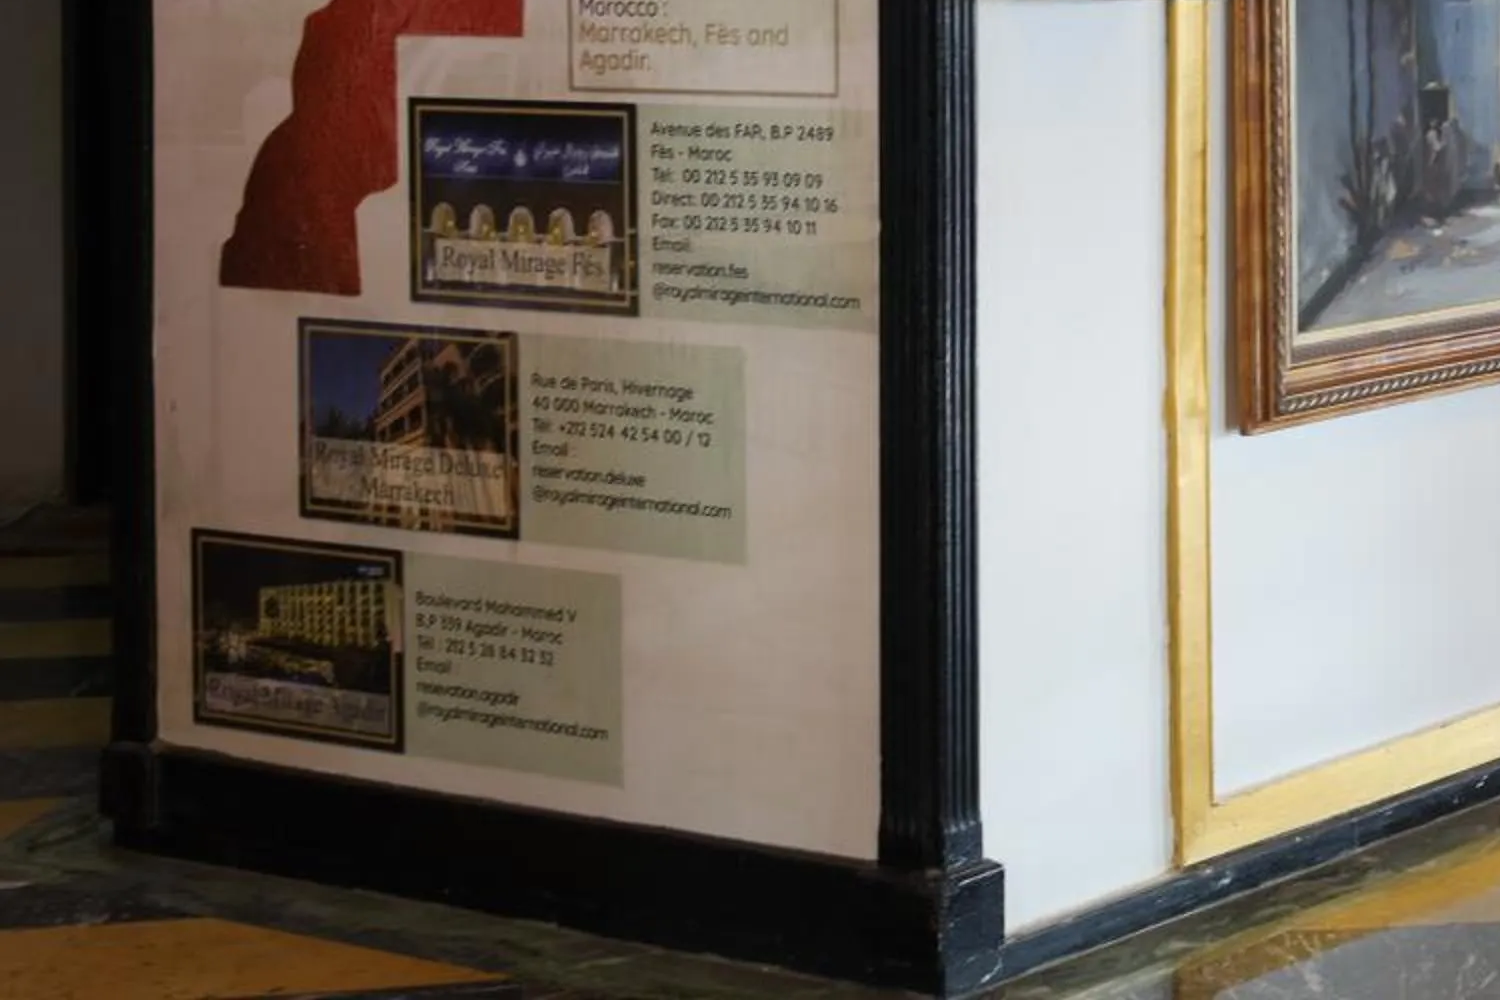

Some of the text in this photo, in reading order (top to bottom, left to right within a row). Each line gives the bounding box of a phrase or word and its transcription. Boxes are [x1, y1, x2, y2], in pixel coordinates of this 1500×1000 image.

[579, 24, 697, 49] Marrakech,
[746, 25, 789, 46] and
[579, 51, 652, 75] Agadir.
[650, 121, 703, 137] Avenue
[705, 122, 731, 139] des
[688, 148, 732, 162] Maroc
[682, 169, 701, 183] 00
[704, 170, 726, 185] 212
[731, 171, 737, 185] 5
[804, 173, 823, 188] 09
[700, 192, 720, 208] 00
[723, 194, 744, 209] 212
[748, 194, 756, 209] 5
[806, 197, 820, 212] 10
[682, 216, 701, 230] 00
[705, 216, 726, 231] 212
[730, 218, 738, 231] 5
[787, 220, 802, 233] 10
[806, 221, 817, 235] 11
[442, 247, 496, 275] Royal
[500, 249, 567, 279] Mirage
[531, 372, 694, 402] Rue de Paris, Hivernage
[532, 396, 550, 410] 40
[553, 398, 579, 413] 000
[583, 400, 657, 419] Marrakech
[670, 408, 714, 425] Maroc
[590, 423, 615, 438] 524
[621, 426, 638, 440] 42
[641, 428, 659, 441] 54
[664, 429, 683, 445] 00
[415, 591, 577, 622] Boulevard Mohammed V
[466, 620, 508, 638] Agadir
[521, 628, 564, 645] Maroc
